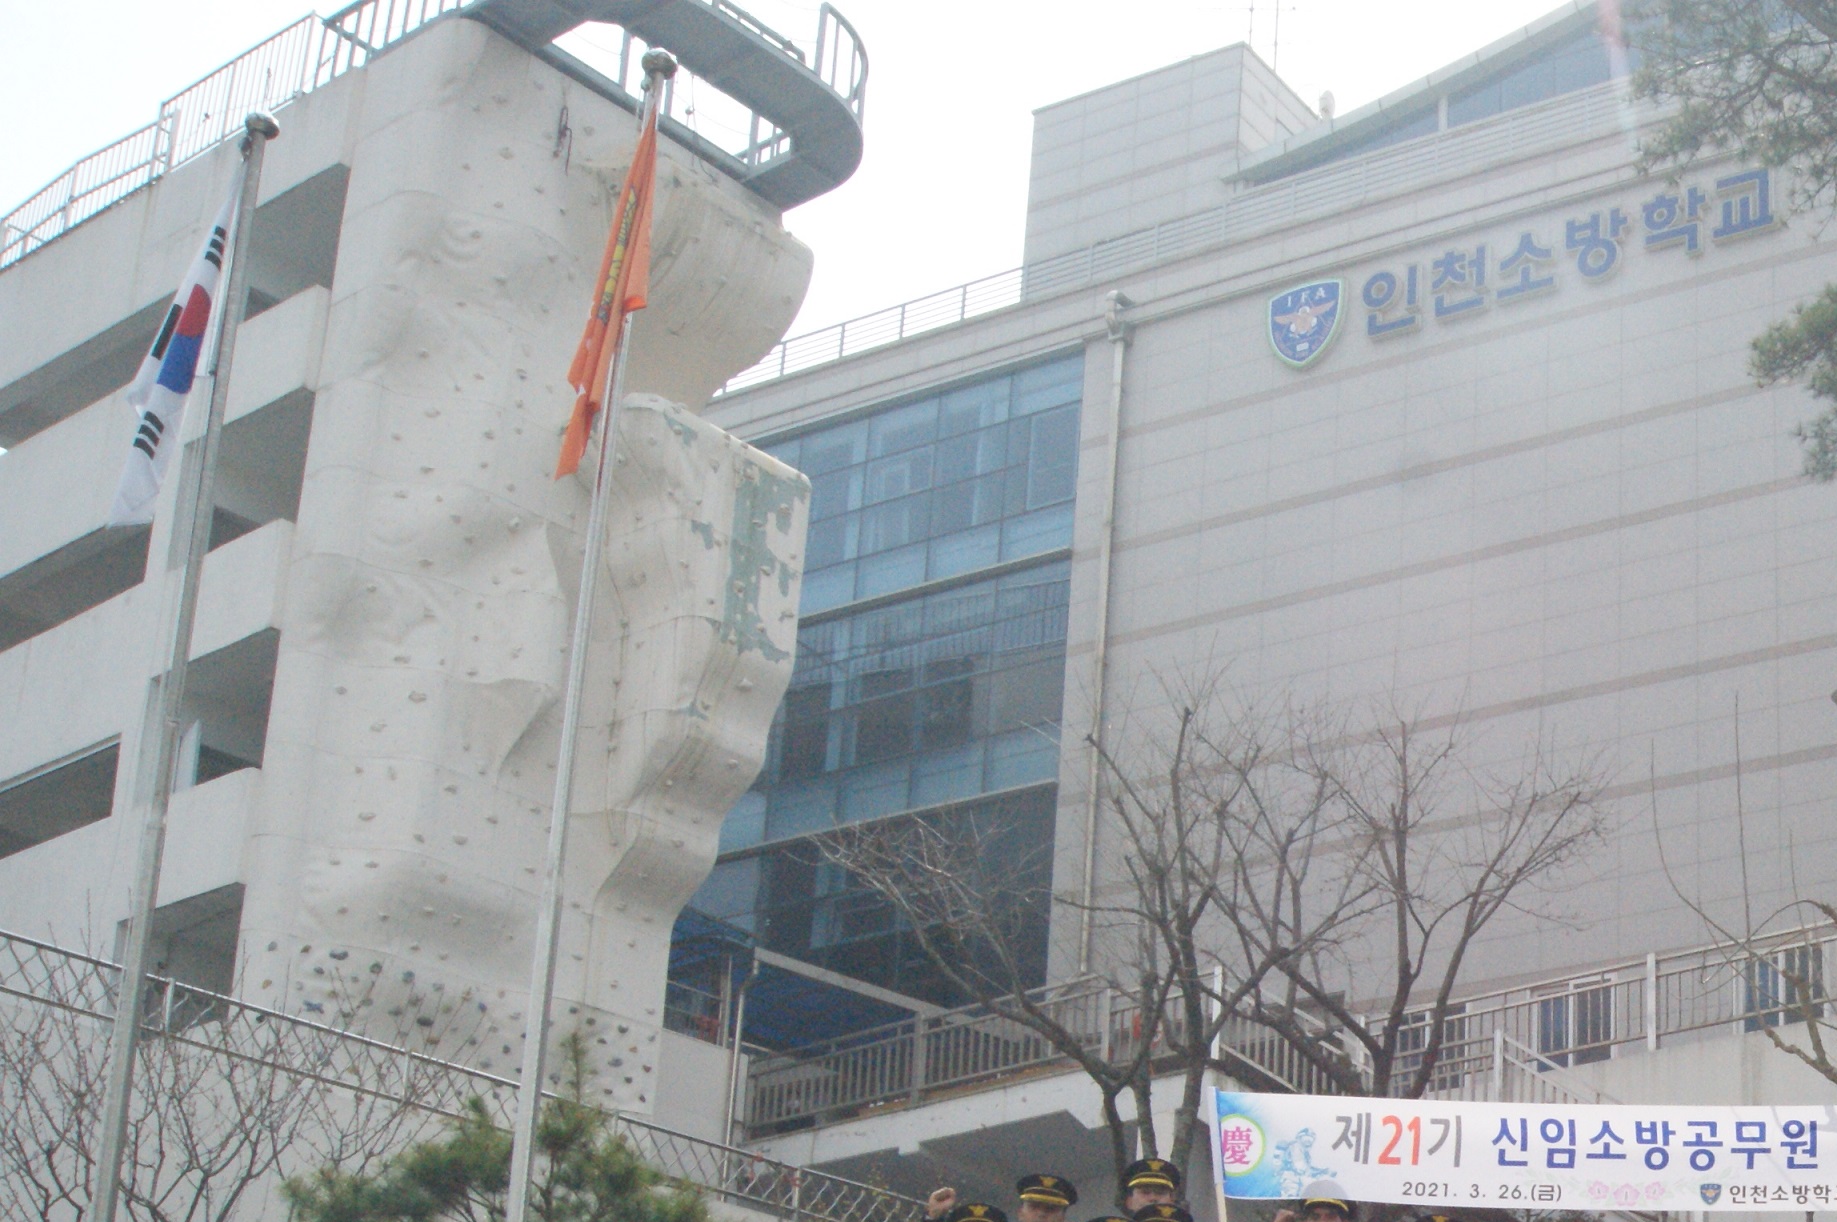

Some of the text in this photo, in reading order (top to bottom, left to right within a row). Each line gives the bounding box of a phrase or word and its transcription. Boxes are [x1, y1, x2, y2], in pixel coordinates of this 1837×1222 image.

[1361, 168, 1775, 337] 인천소방학교
[1287, 287, 1326, 307] IFA
[1222, 1126, 1253, 1166] 慶
[1331, 1112, 1462, 1168] 제21기
[1491, 1117, 1819, 1172] 신임소방공무원
[1402, 1181, 1562, 1202] 2021. 3. 26.(금)
